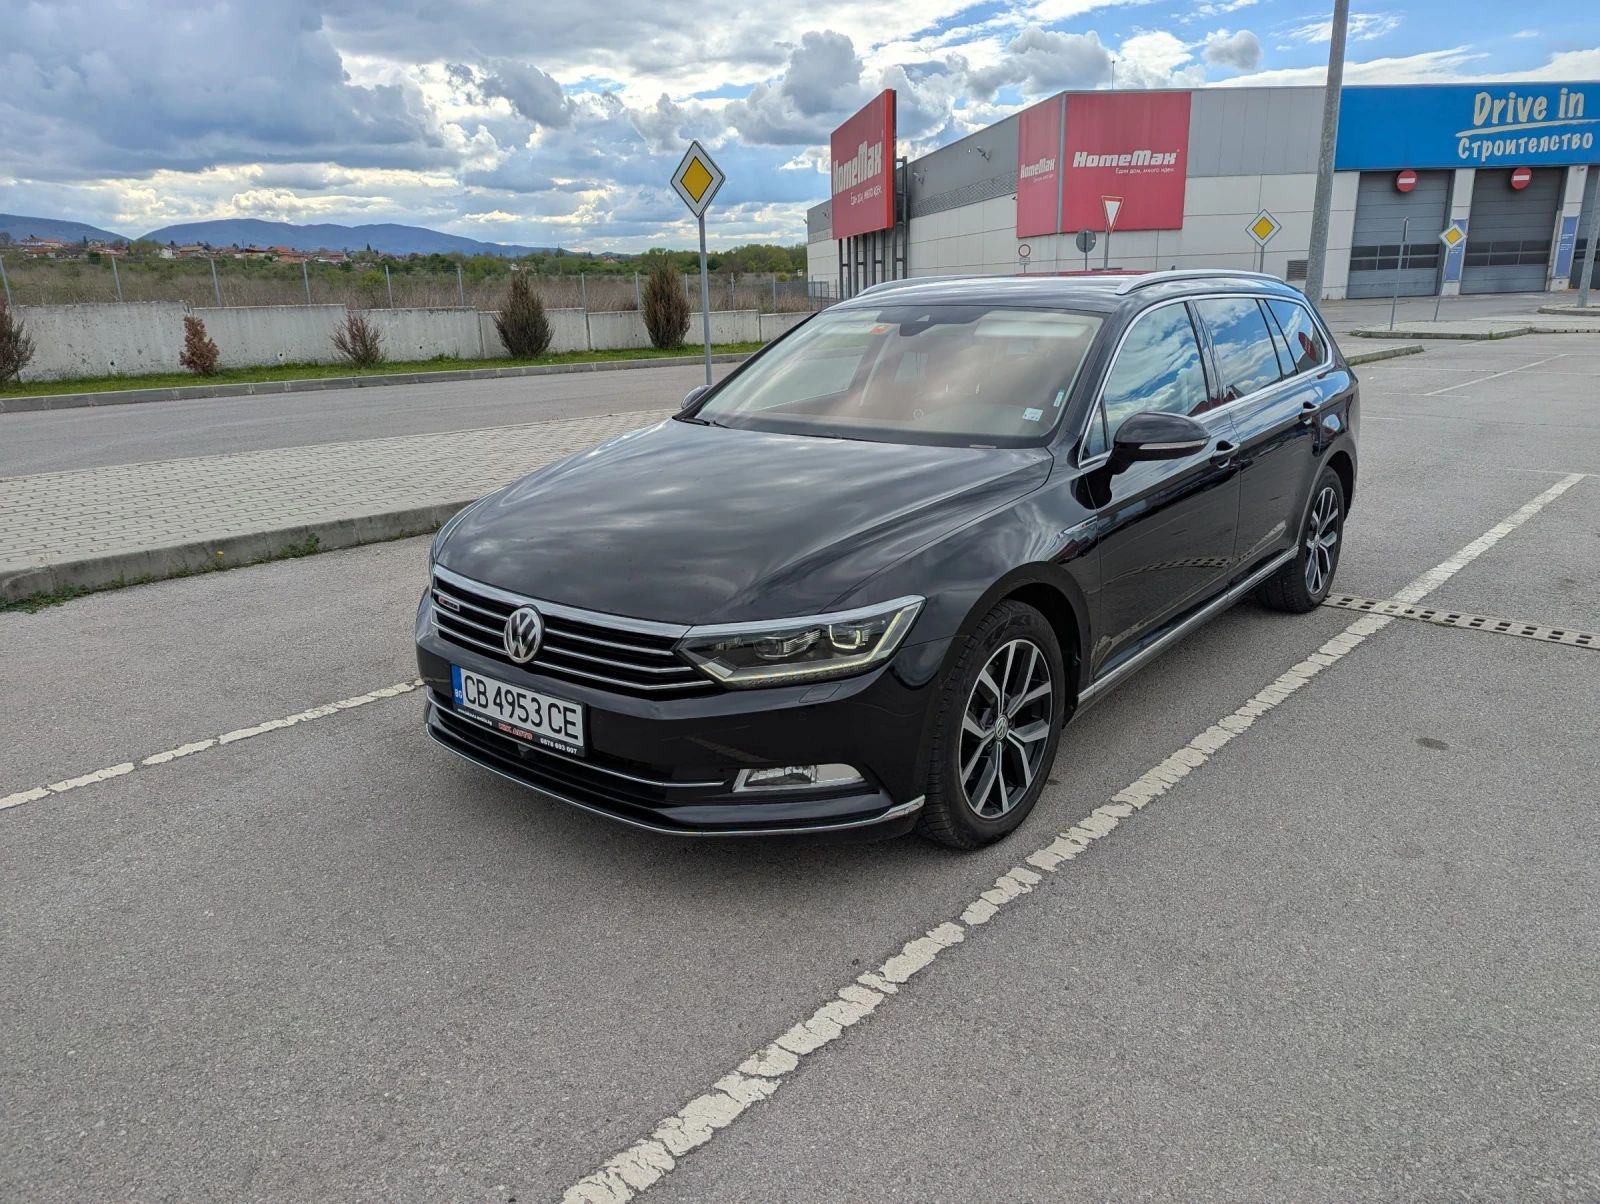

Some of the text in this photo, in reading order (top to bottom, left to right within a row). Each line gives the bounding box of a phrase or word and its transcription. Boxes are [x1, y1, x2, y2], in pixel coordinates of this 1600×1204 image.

[1473, 87, 1585, 126] Drive in
[1072, 149, 1178, 168] HomeMax
[1458, 132, 1594, 162] Строителство
[832, 140, 883, 196] HomeMax
[1020, 157, 1056, 179] HomeMax
[464, 674, 489, 709] CB
[492, 685, 543, 728] 4953
[547, 702, 579, 741] CE
